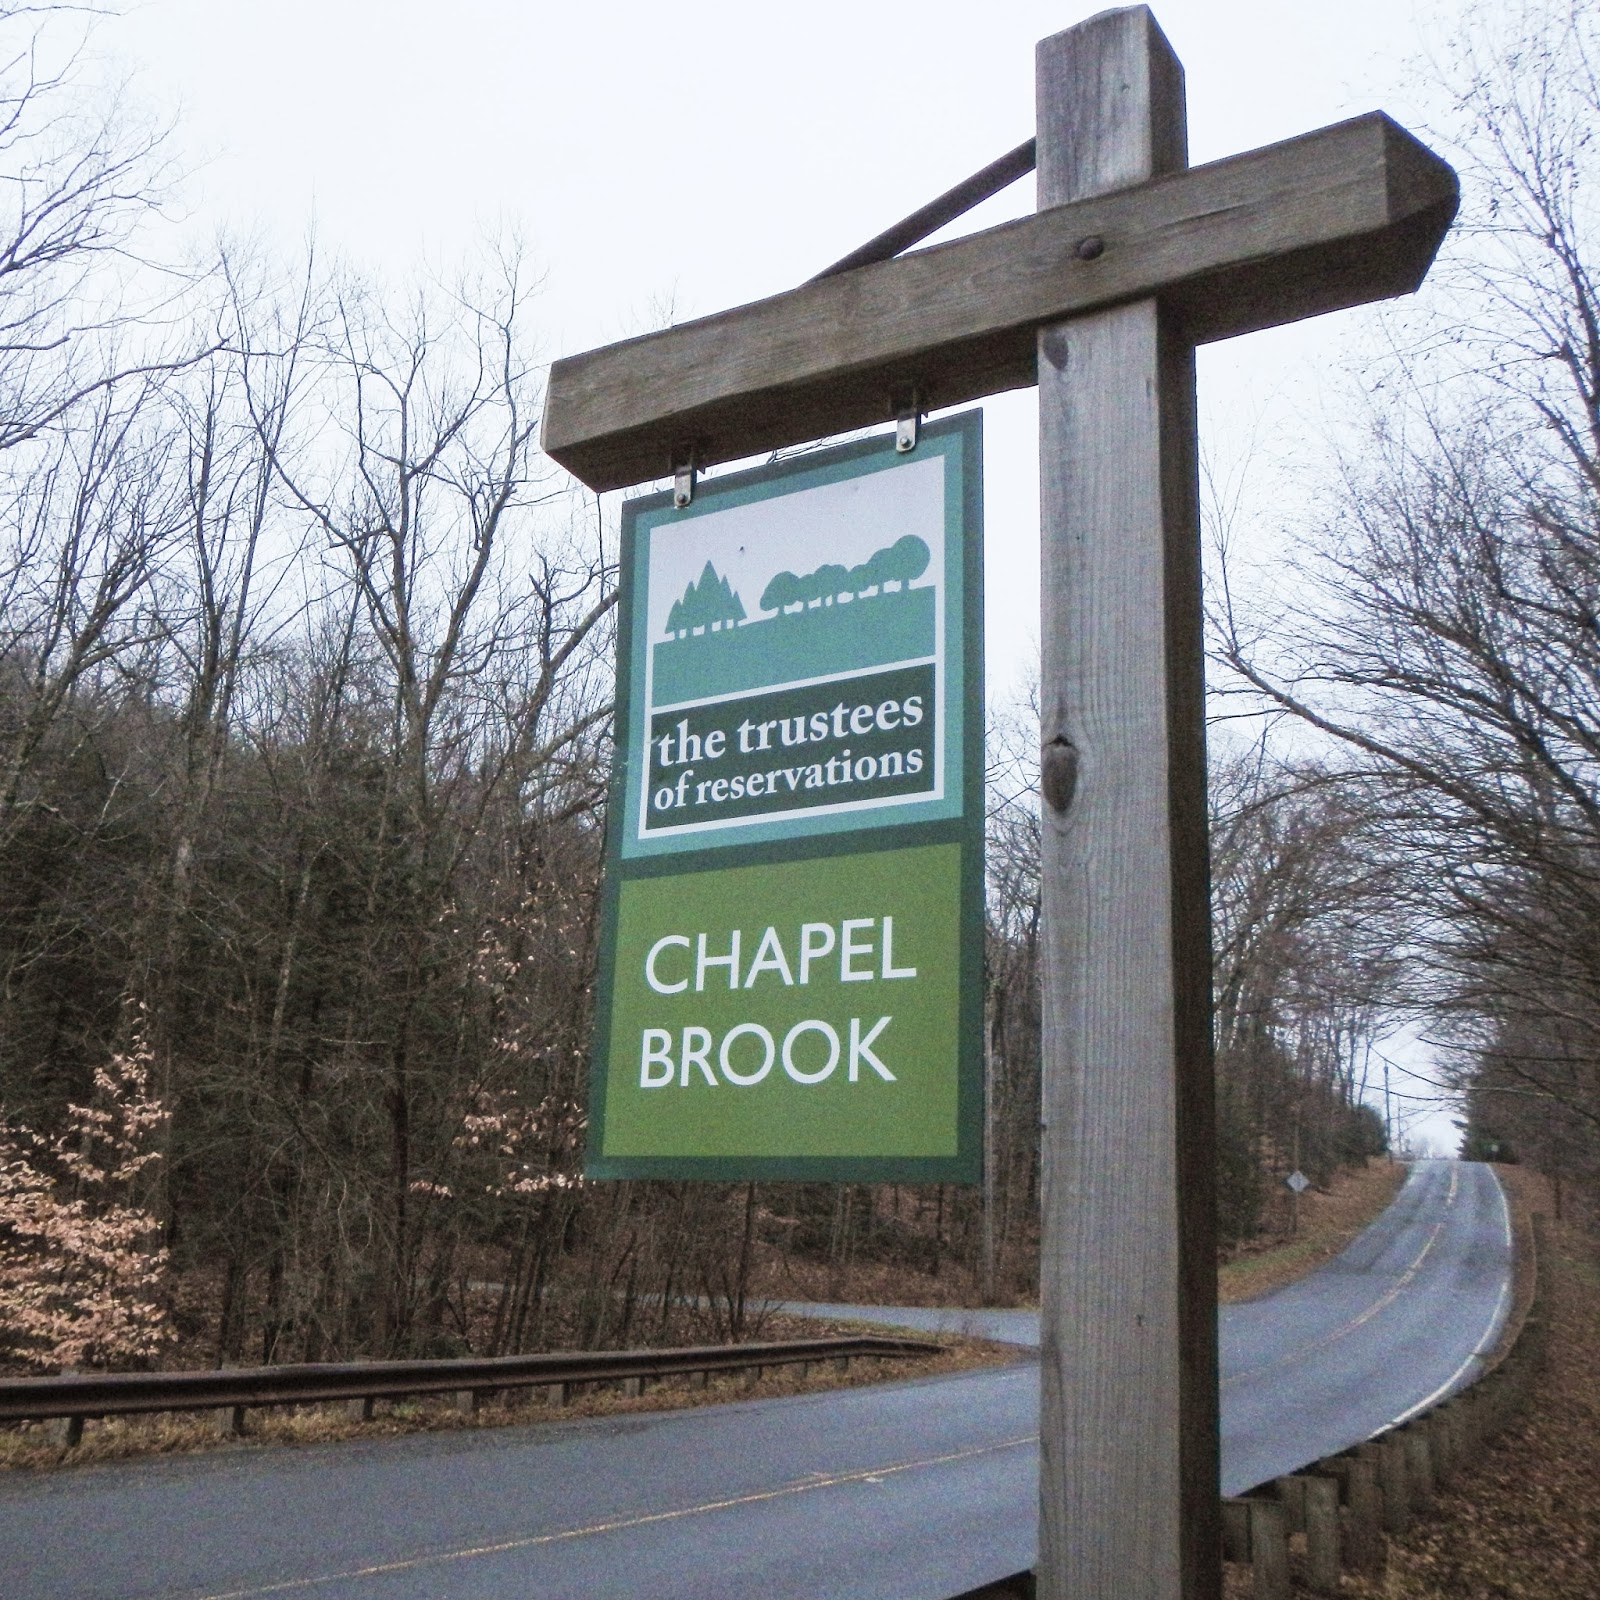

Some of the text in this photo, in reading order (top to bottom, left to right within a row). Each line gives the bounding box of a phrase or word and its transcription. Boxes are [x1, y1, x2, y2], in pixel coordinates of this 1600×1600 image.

[658, 695, 923, 767] the trustees
[654, 748, 923, 810] of reservations
[645, 916, 917, 994] CHAPEL
[639, 1016, 897, 1088] BROOK
